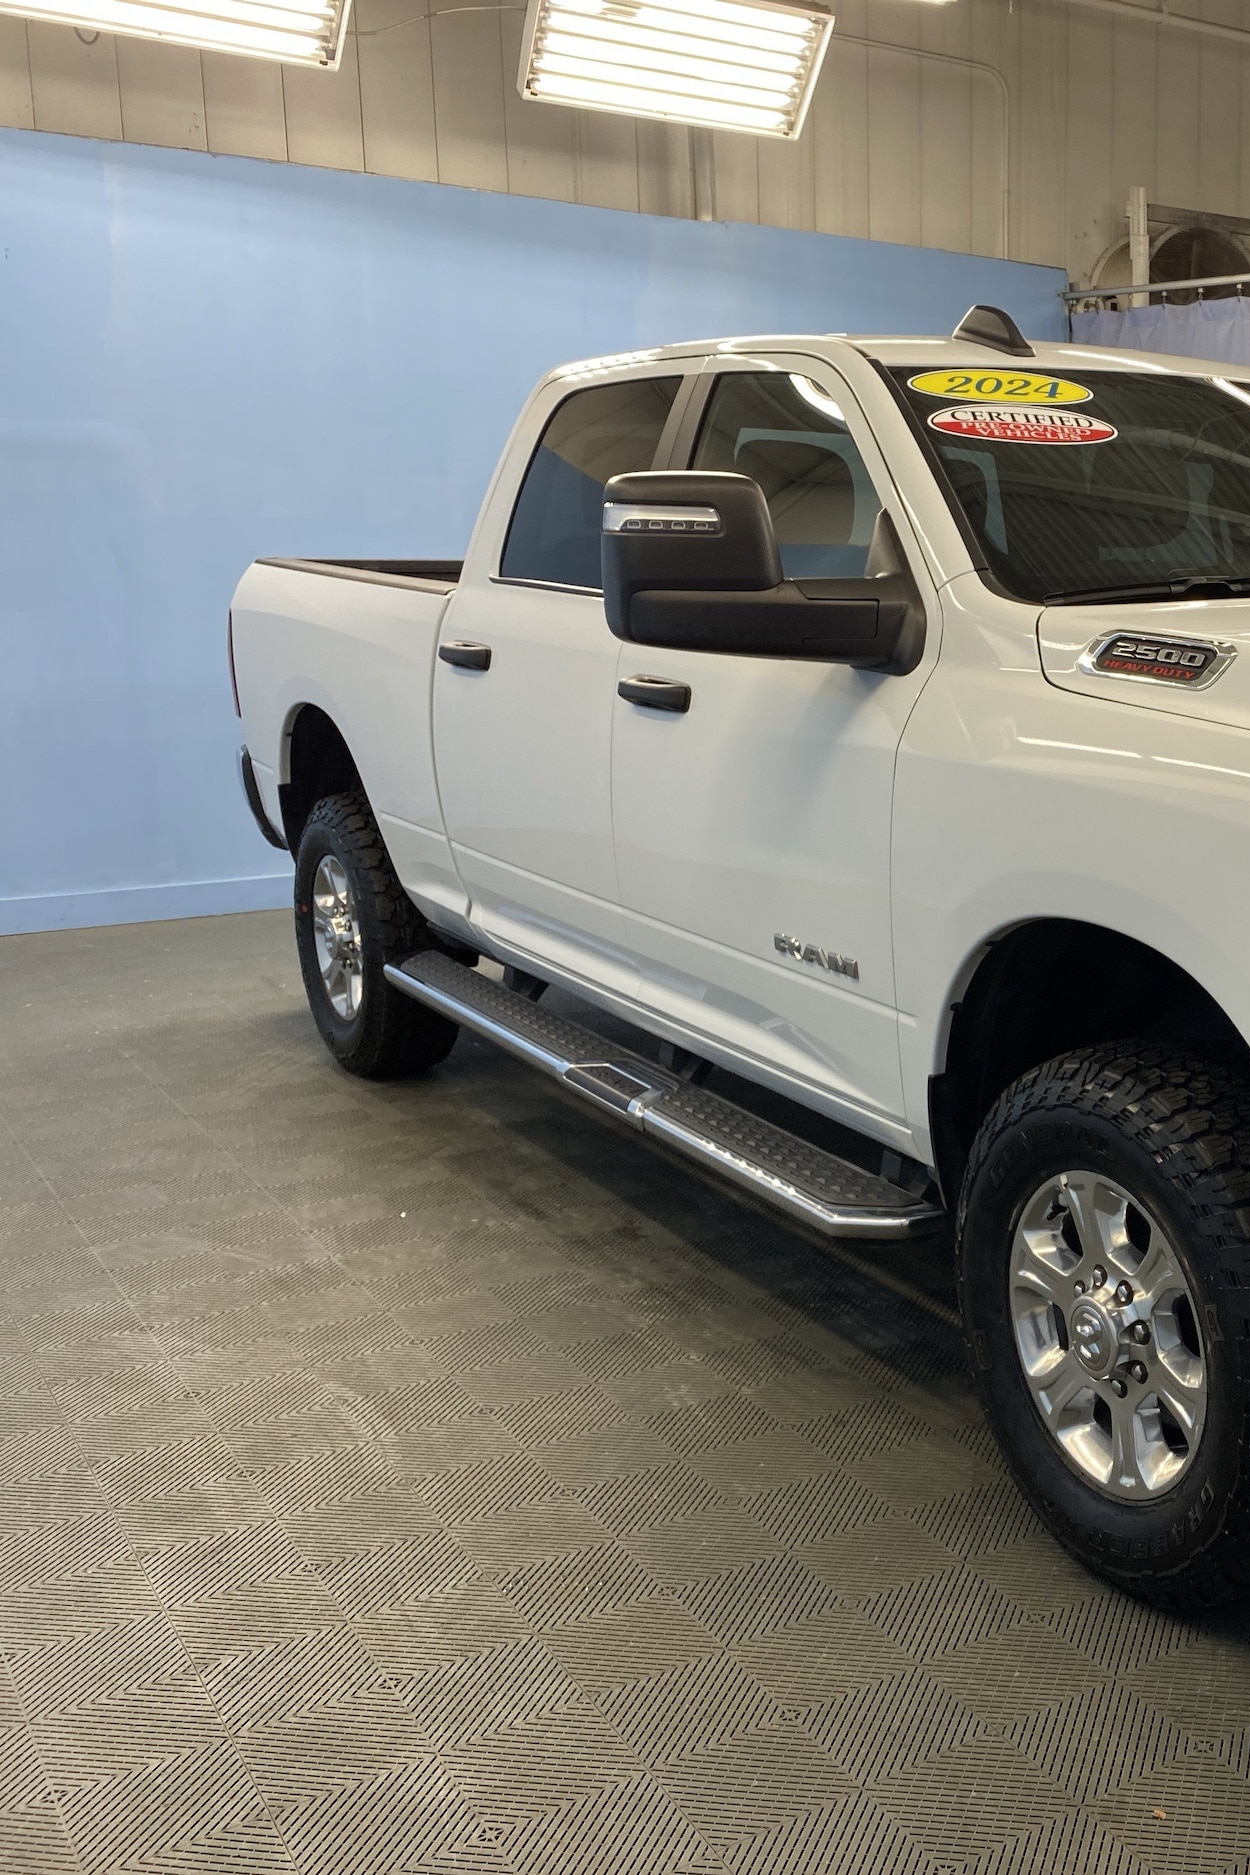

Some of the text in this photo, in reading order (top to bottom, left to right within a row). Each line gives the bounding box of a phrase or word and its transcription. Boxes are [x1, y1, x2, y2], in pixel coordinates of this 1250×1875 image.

[943, 375, 1063, 399] 2024
[950, 409, 1093, 428] CERTIFIED
[959, 421, 1091, 436] PRE-OWNED
[976, 428, 1082, 442] VEHICLES
[1111, 641, 1206, 667] 2500
[1103, 659, 1196, 680] HEAVY DUTY
[773, 932, 860, 980] RAM
